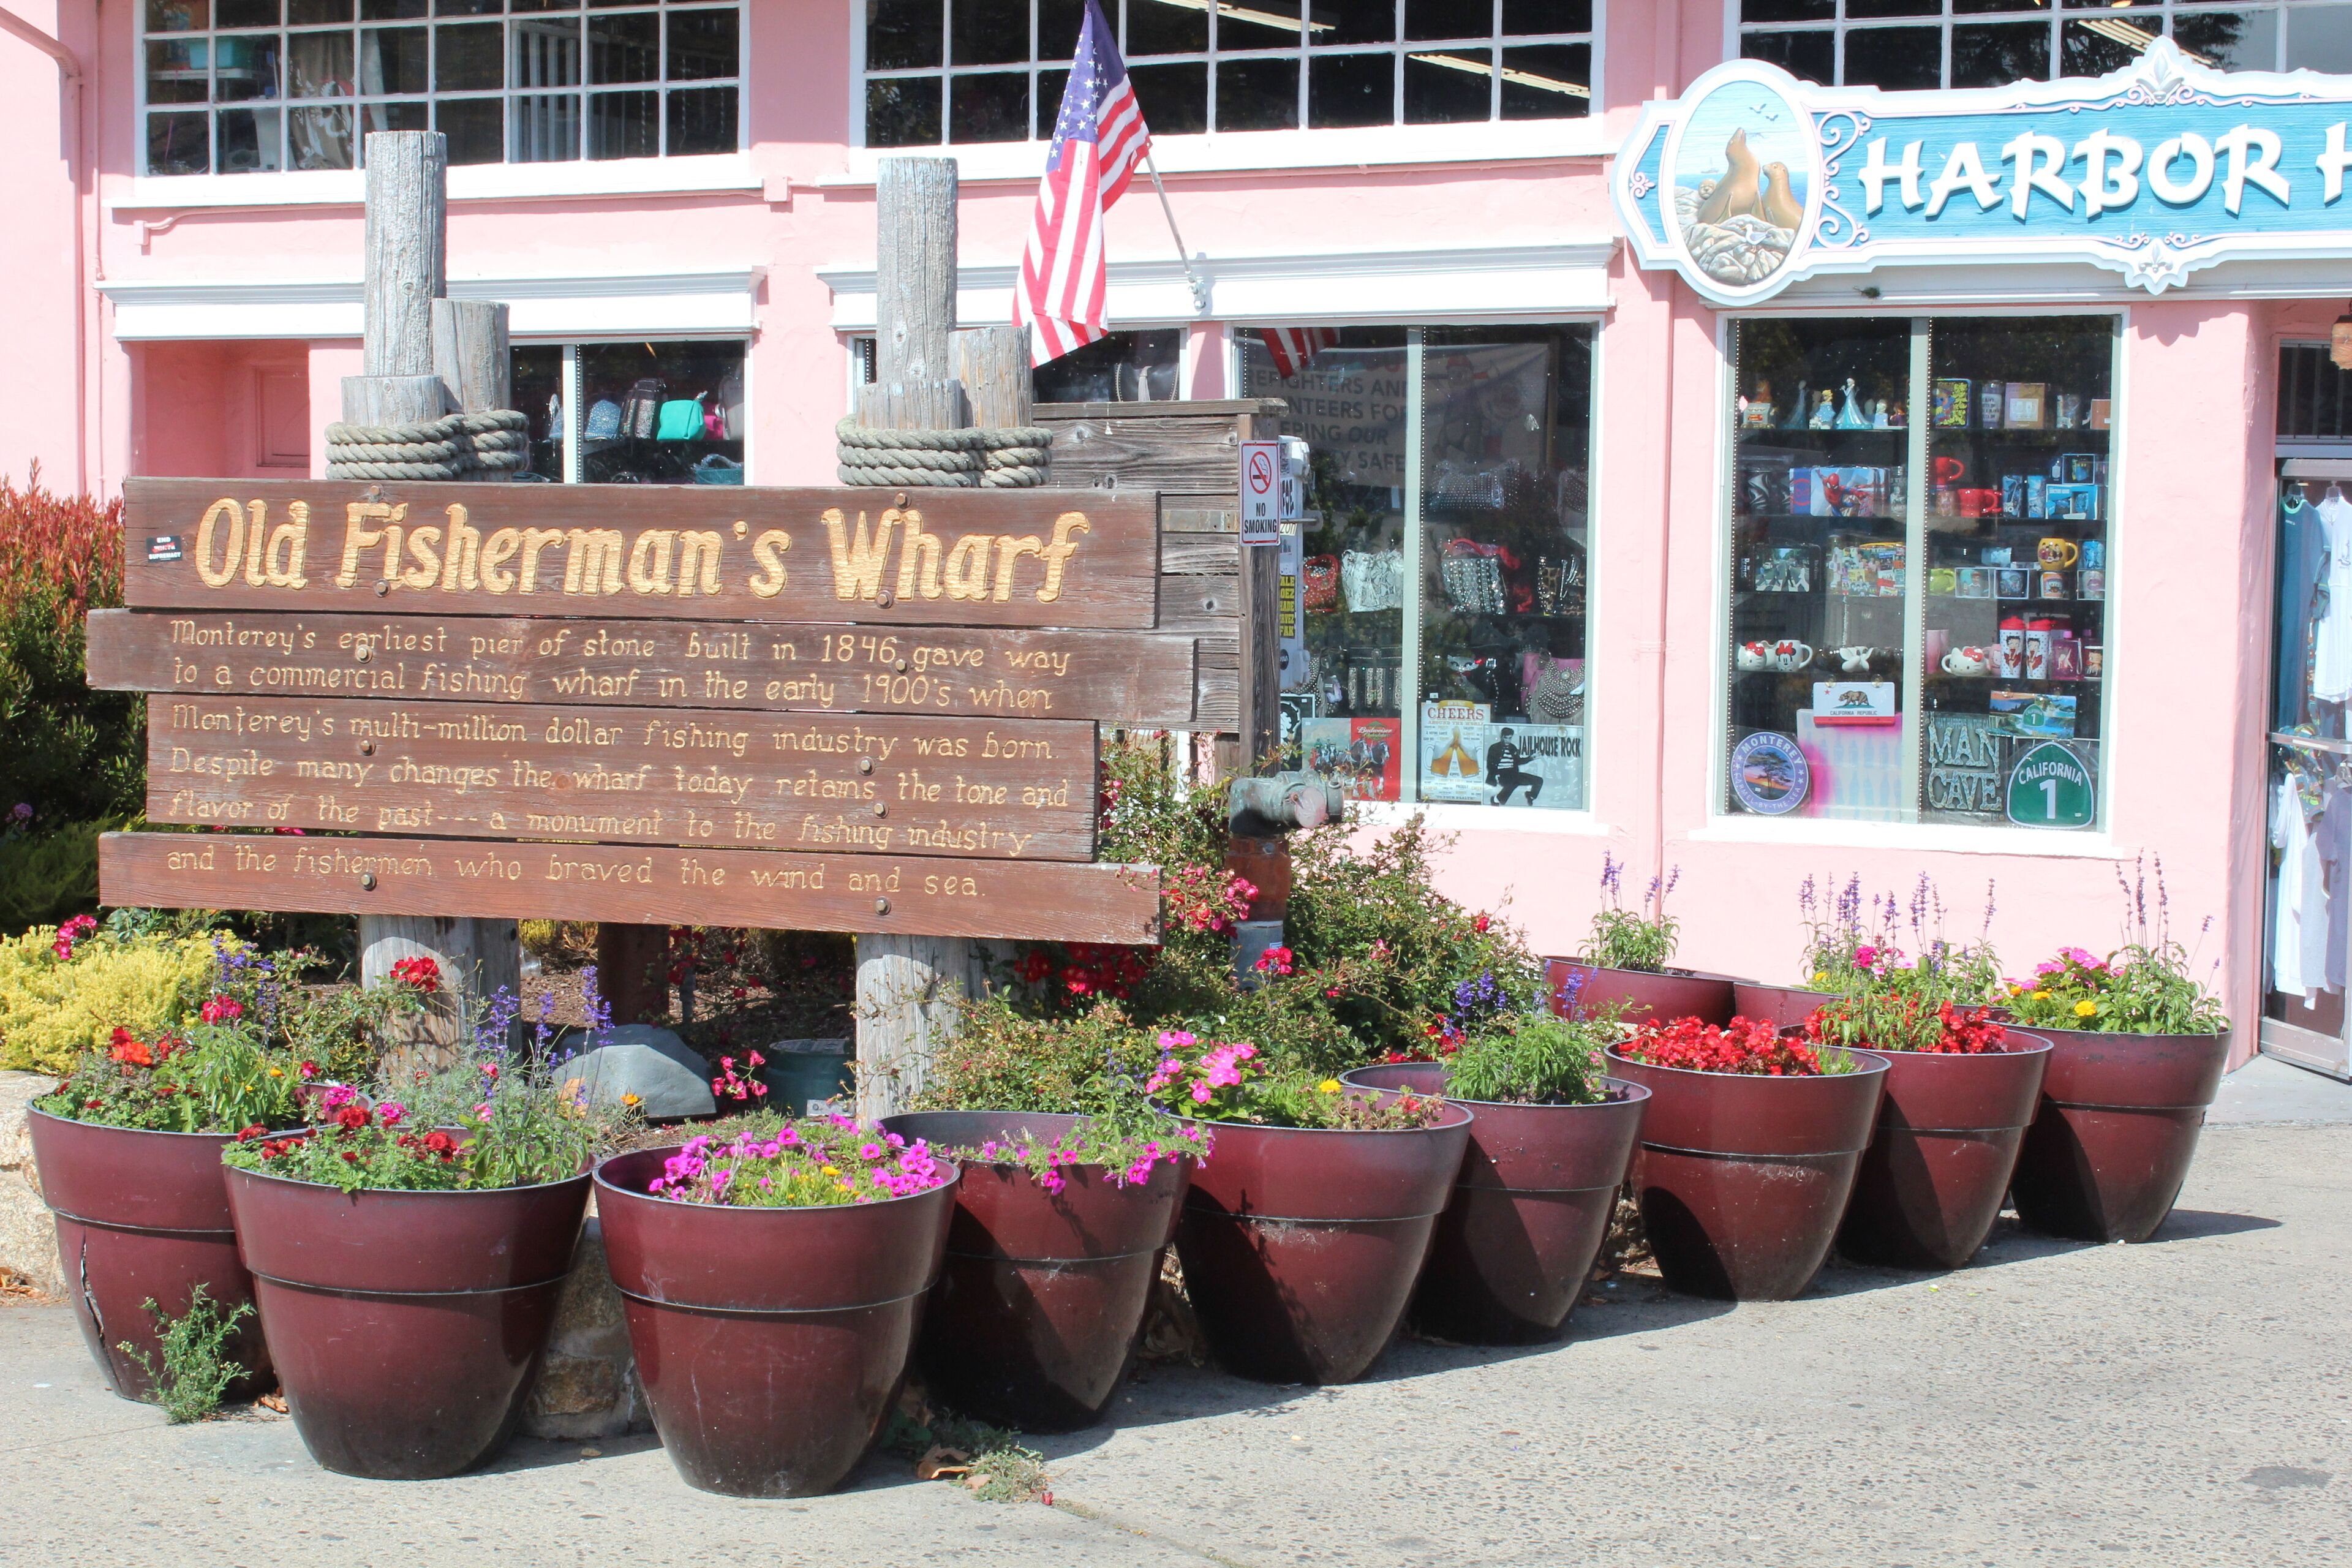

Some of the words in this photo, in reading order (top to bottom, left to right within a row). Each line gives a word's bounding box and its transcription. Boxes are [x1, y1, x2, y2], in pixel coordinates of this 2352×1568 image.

[1858, 120, 2290, 221] HARBOR
[1348, 426, 1389, 446] OUR
[1244, 519, 1277, 534] SMOKING
[1256, 502, 1266, 517] NO
[195, 498, 309, 589] Old
[335, 500, 791, 598] Fisherman's
[821, 508, 1090, 603] Wharf
[170, 620, 315, 655] Monterey's
[340, 624, 447, 654] earliest
[470, 637, 522, 659] pier
[540, 629, 571, 656] of
[584, 630, 654, 659] stone
[685, 631, 752, 660] built
[773, 634, 795, 660] in
[914, 645, 985, 673] gave
[1005, 650, 1071, 676] way
[174, 658, 198, 684] to
[216, 665, 233, 685] a
[250, 663, 405, 690] commercial
[421, 663, 527, 699] fishing
[551, 667, 641, 697] wharf
[660, 677, 685, 699] in
[706, 670, 747, 700] the
[766, 673, 835, 708] early
[862, 674, 951, 707] 1900's
[970, 679, 1052, 709] when
[173, 705, 334, 741] Monterey's
[349, 712, 527, 742] multi-million
[545, 718, 624, 745] dollar
[644, 720, 748, 756] fishing
[773, 726, 899, 760] industry
[914, 736, 968, 756] was
[1427, 707, 1484, 721] CHEERS
[1519, 736, 1558, 757] JAILHOUSE
[1562, 737, 1581, 757] ROCK
[1741, 735, 1803, 765] MONTEREY
[1928, 726, 2000, 768] MAN
[170, 747, 274, 782] Despite
[298, 758, 372, 787] many
[390, 756, 500, 794] changes
[513, 760, 552, 788] the
[573, 763, 652, 791] wharf
[675, 766, 752, 804] today
[775, 769, 875, 801] retains
[898, 769, 941, 801] the
[956, 775, 1007, 806] tone
[1022, 780, 1068, 807] and
[1928, 768, 2002, 811] CAVE
[2018, 762, 2082, 786] CALIFORNIA
[2039, 778, 2056, 820] 1
[169, 790, 252, 819] flavor
[267, 794, 294, 820] of
[318, 796, 359, 824] the
[489, 812, 507, 831] a
[528, 810, 663, 837] monument
[687, 810, 713, 838] to
[735, 812, 775, 840] the
[798, 815, 893, 850] fishing
[907, 819, 1033, 856] industry
[167, 846, 215, 870] and
[235, 845, 276, 872] the
[294, 846, 432, 875] fishermen
[455, 851, 521, 880] who
[546, 854, 653, 884] braved
[679, 860, 725, 887] the
[750, 864, 824, 889] wind
[849, 867, 900, 892] and
[924, 871, 986, 897] sea.
